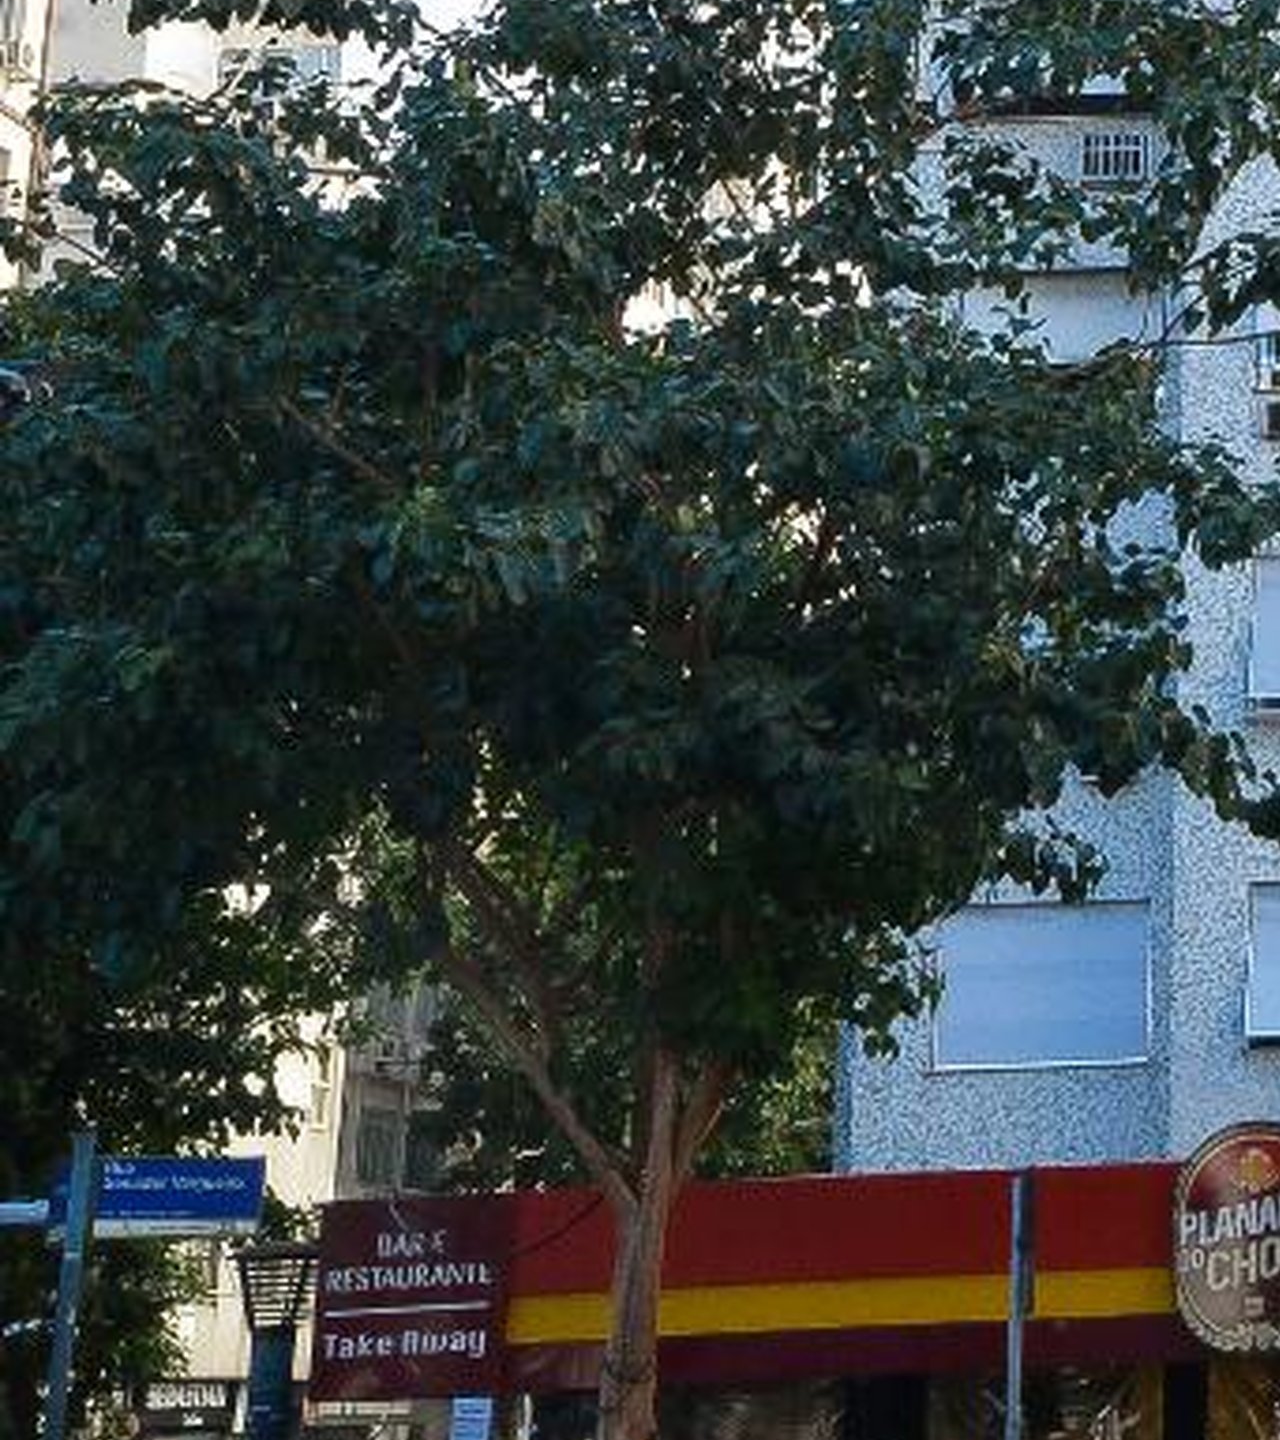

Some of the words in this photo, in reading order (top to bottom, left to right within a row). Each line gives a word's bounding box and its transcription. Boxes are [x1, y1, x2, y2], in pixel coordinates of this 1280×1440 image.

[376, 1232, 424, 1258] BAR
[325, 1261, 492, 1293] RESTAURANTE
[323, 1332, 393, 1359] Take
[401, 1328, 486, 1359] Away
